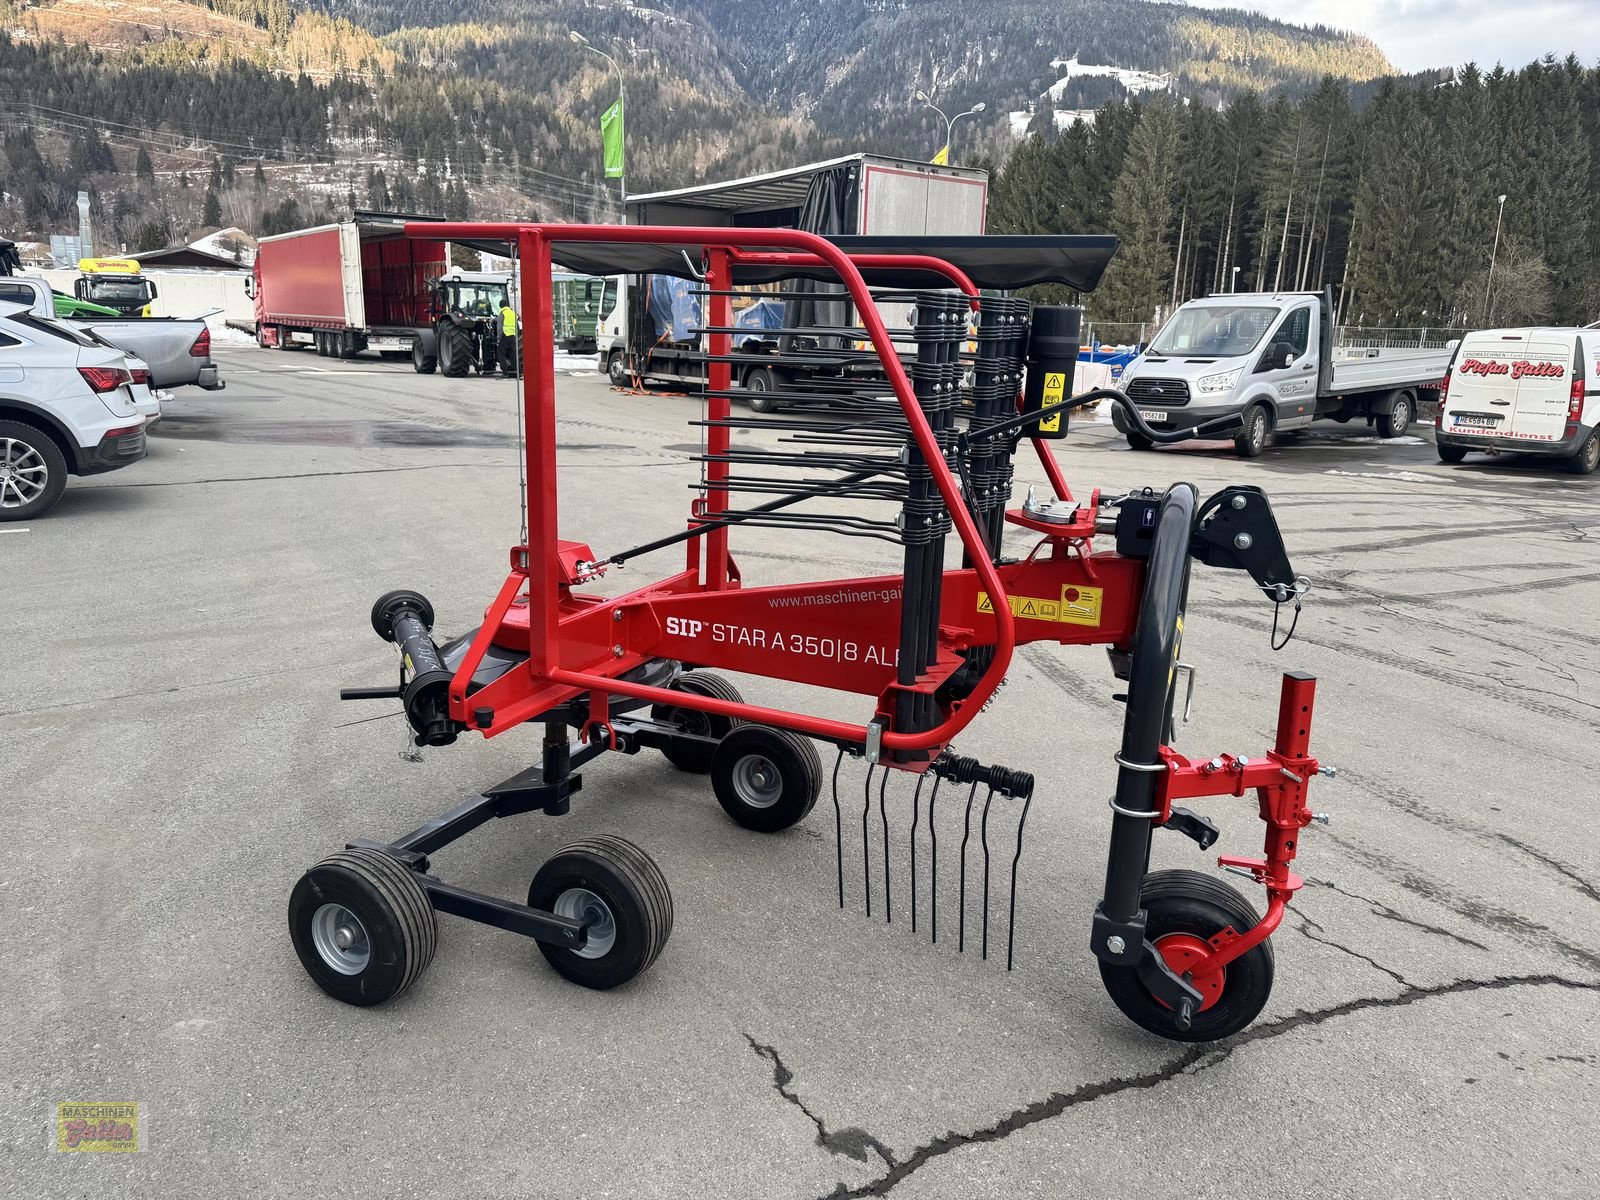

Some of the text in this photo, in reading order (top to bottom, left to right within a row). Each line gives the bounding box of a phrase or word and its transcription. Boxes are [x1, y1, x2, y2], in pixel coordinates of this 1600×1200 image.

[1459, 359, 1565, 380] Stefan Gailer
[1449, 426, 1554, 440] Kundendienst
[666, 616, 702, 638] SIP
[712, 623, 766, 648] STAR
[771, 632, 785, 651] A
